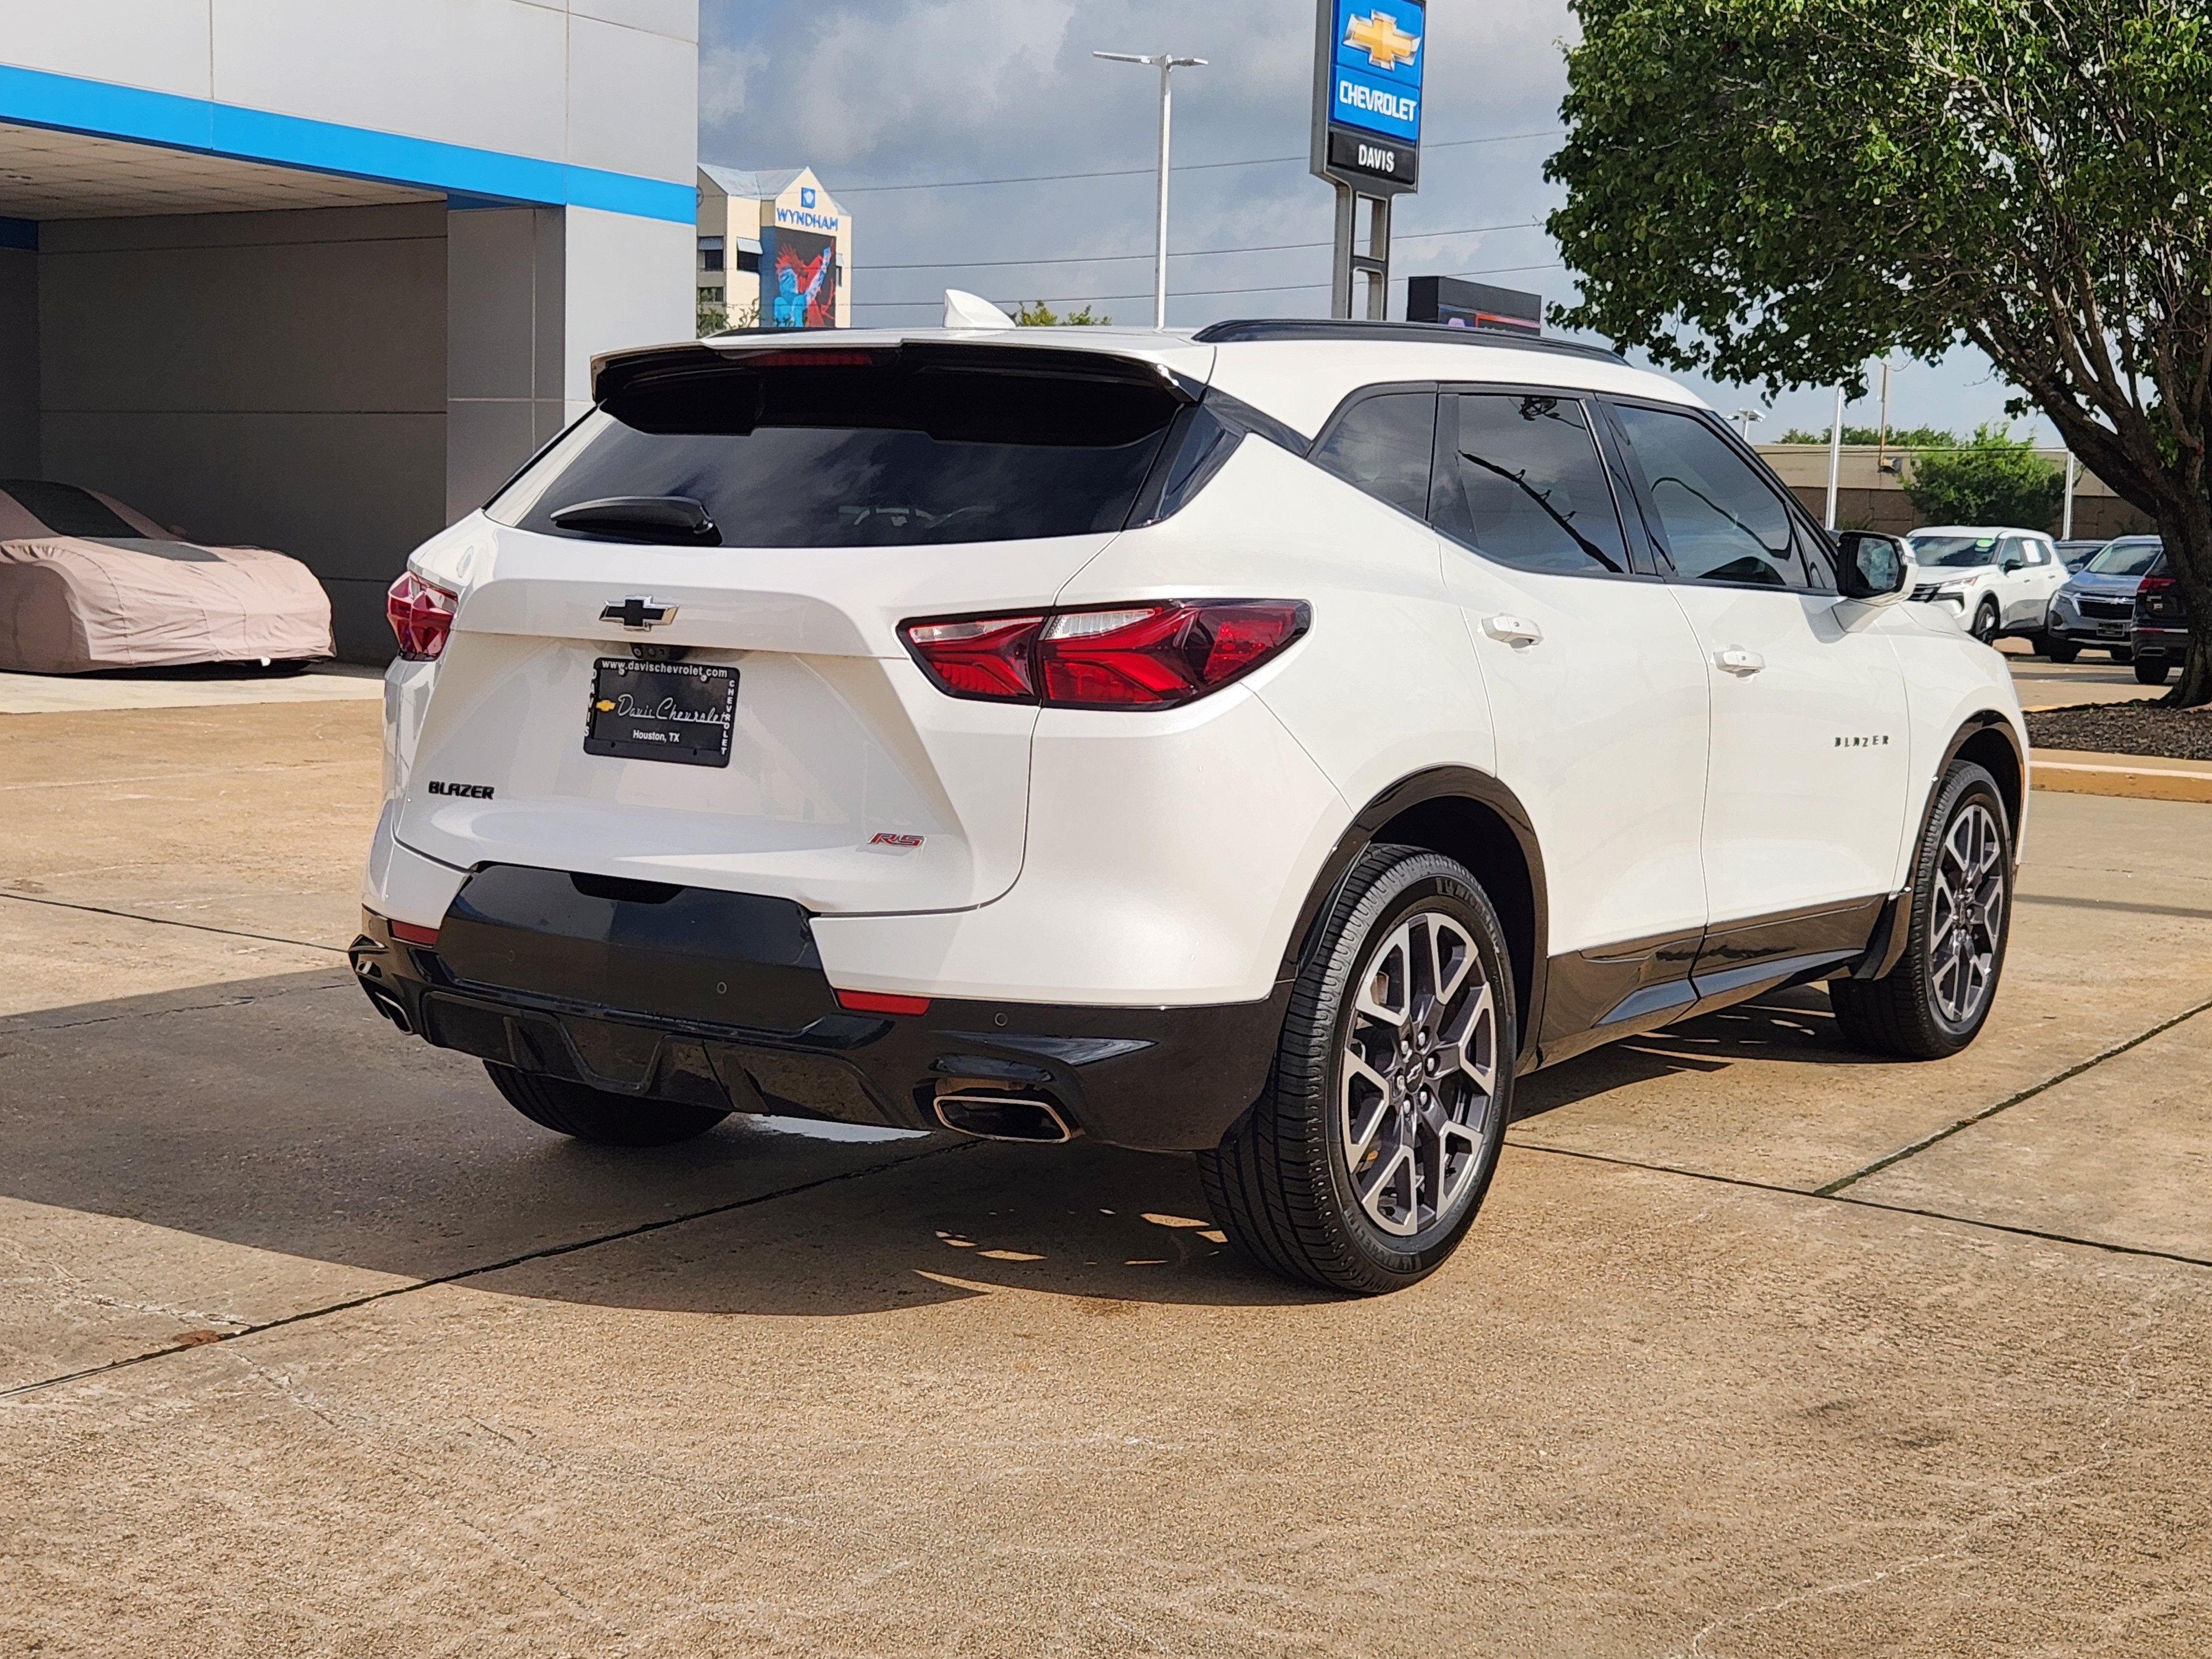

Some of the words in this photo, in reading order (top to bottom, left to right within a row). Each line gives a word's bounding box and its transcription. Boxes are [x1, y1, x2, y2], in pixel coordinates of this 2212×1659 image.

[1339, 80, 1418, 122] CHEVROLET
[1358, 144, 1395, 173] DAVIS
[776, 207, 839, 231] WYNDHAM
[601, 660, 728, 678] www.davischevrolet.com
[617, 693, 656, 719] Davis
[655, 697, 728, 725] Chevrolet
[633, 729, 667, 743] Houston,
[669, 732, 681, 742] TX
[1834, 735, 1889, 747] BLAZER
[428, 780, 495, 800] BLAZER
[867, 832, 926, 848] RS
